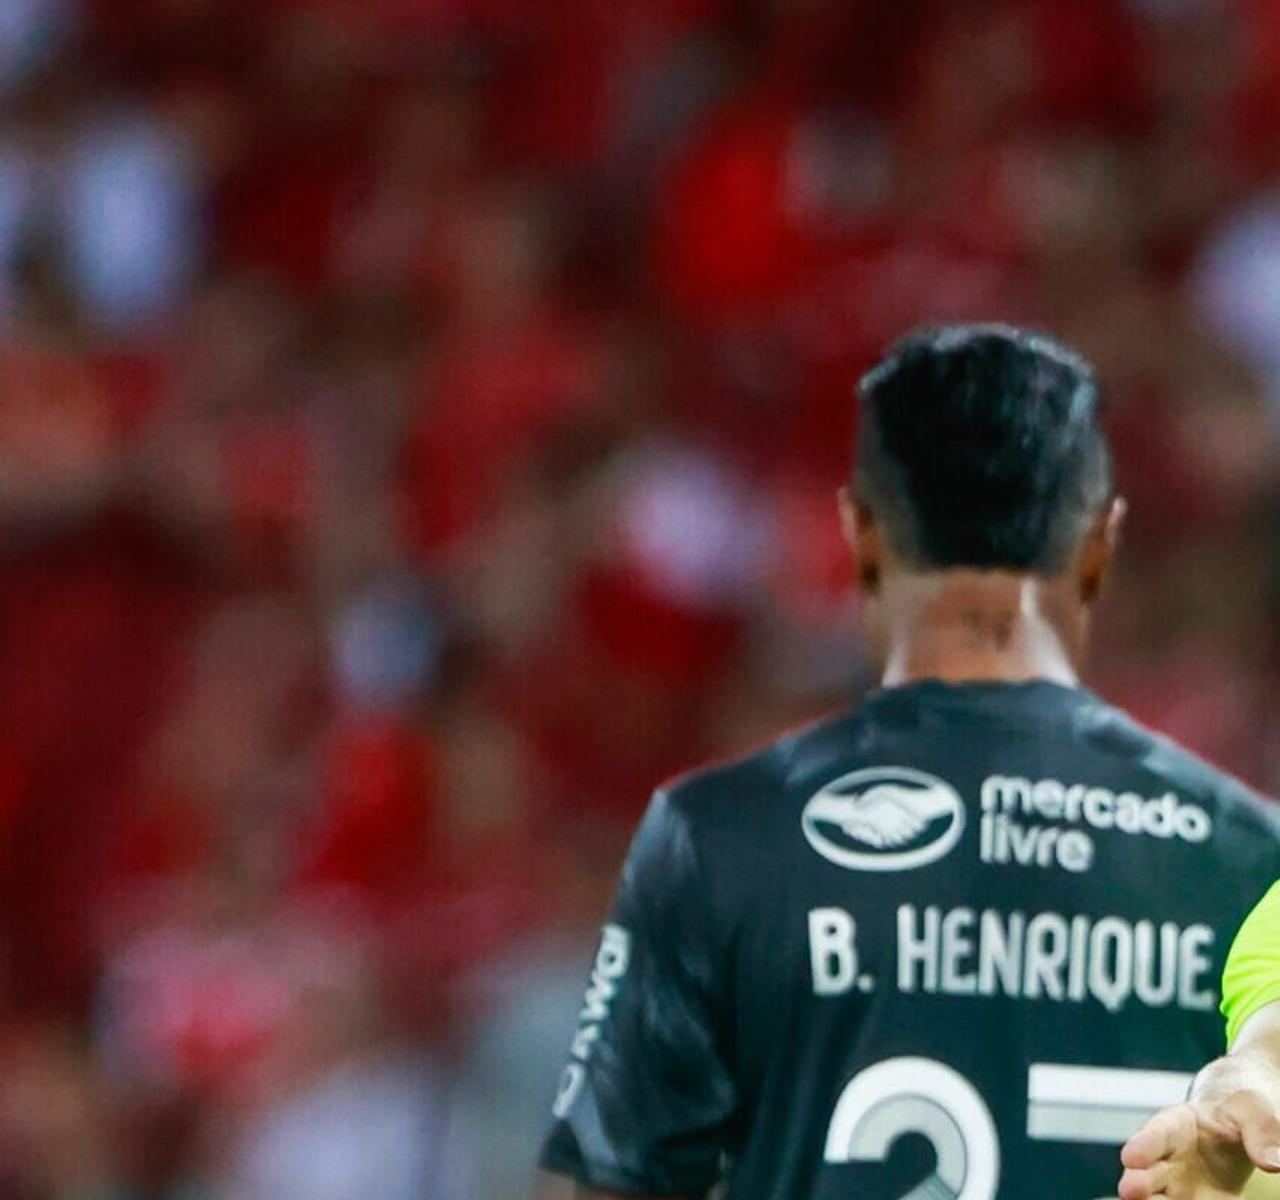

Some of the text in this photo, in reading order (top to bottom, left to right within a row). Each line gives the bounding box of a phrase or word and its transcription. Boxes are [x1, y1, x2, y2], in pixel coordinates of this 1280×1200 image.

[980, 774, 1212, 843] mercado
[980, 820, 1092, 872] livre
[808, 904, 1216, 1011] B. HENRIQUE
